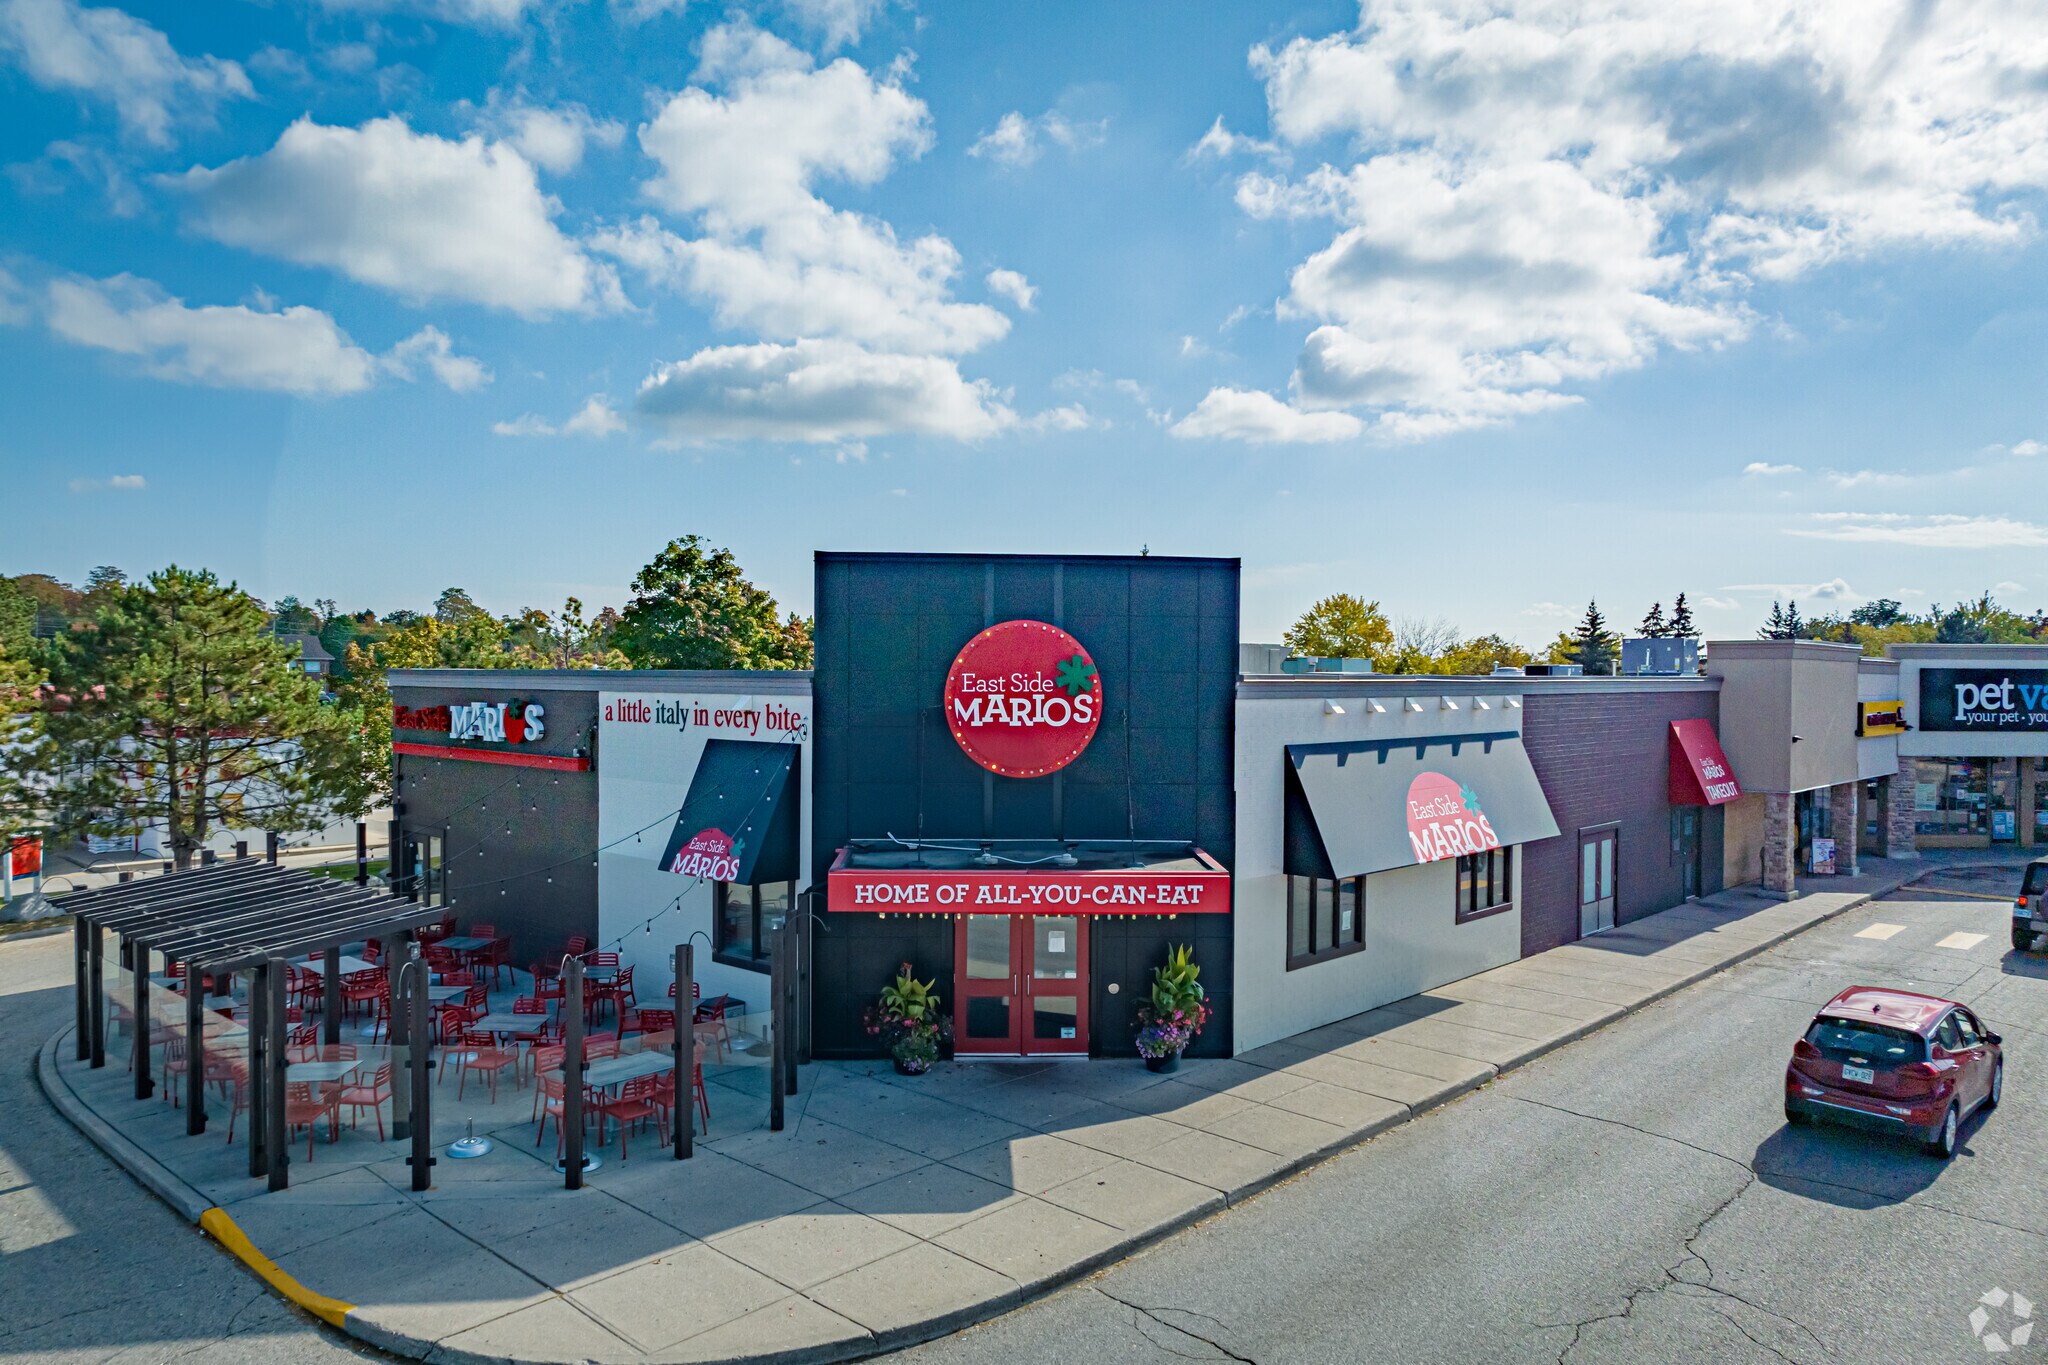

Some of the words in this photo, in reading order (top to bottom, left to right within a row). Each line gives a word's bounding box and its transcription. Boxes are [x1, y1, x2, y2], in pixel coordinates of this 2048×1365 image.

[961, 673, 1006, 692] East
[1010, 671, 1054, 693] Side
[954, 693, 1093, 727] MARIOS
[1955, 678, 2015, 721] pet
[605, 705, 613, 721] a
[617, 698, 651, 723] little
[655, 699, 689, 732] italy
[693, 701, 709, 726] in
[714, 709, 761, 736] every
[1966, 712, 1997, 725] your
[1999, 710, 2019, 725] pet
[1705, 781, 1738, 800] TAKEOUT
[1409, 801, 1438, 819] East
[1434, 795, 1460, 816] Side
[689, 837, 707, 851] East
[707, 839, 726, 854] Side
[1409, 815, 1499, 864] MARIOS
[855, 883, 930, 904] HOME
[935, 884, 970, 904] OF
[974, 884, 1204, 905] ALL-YOU-CAN-EAT
